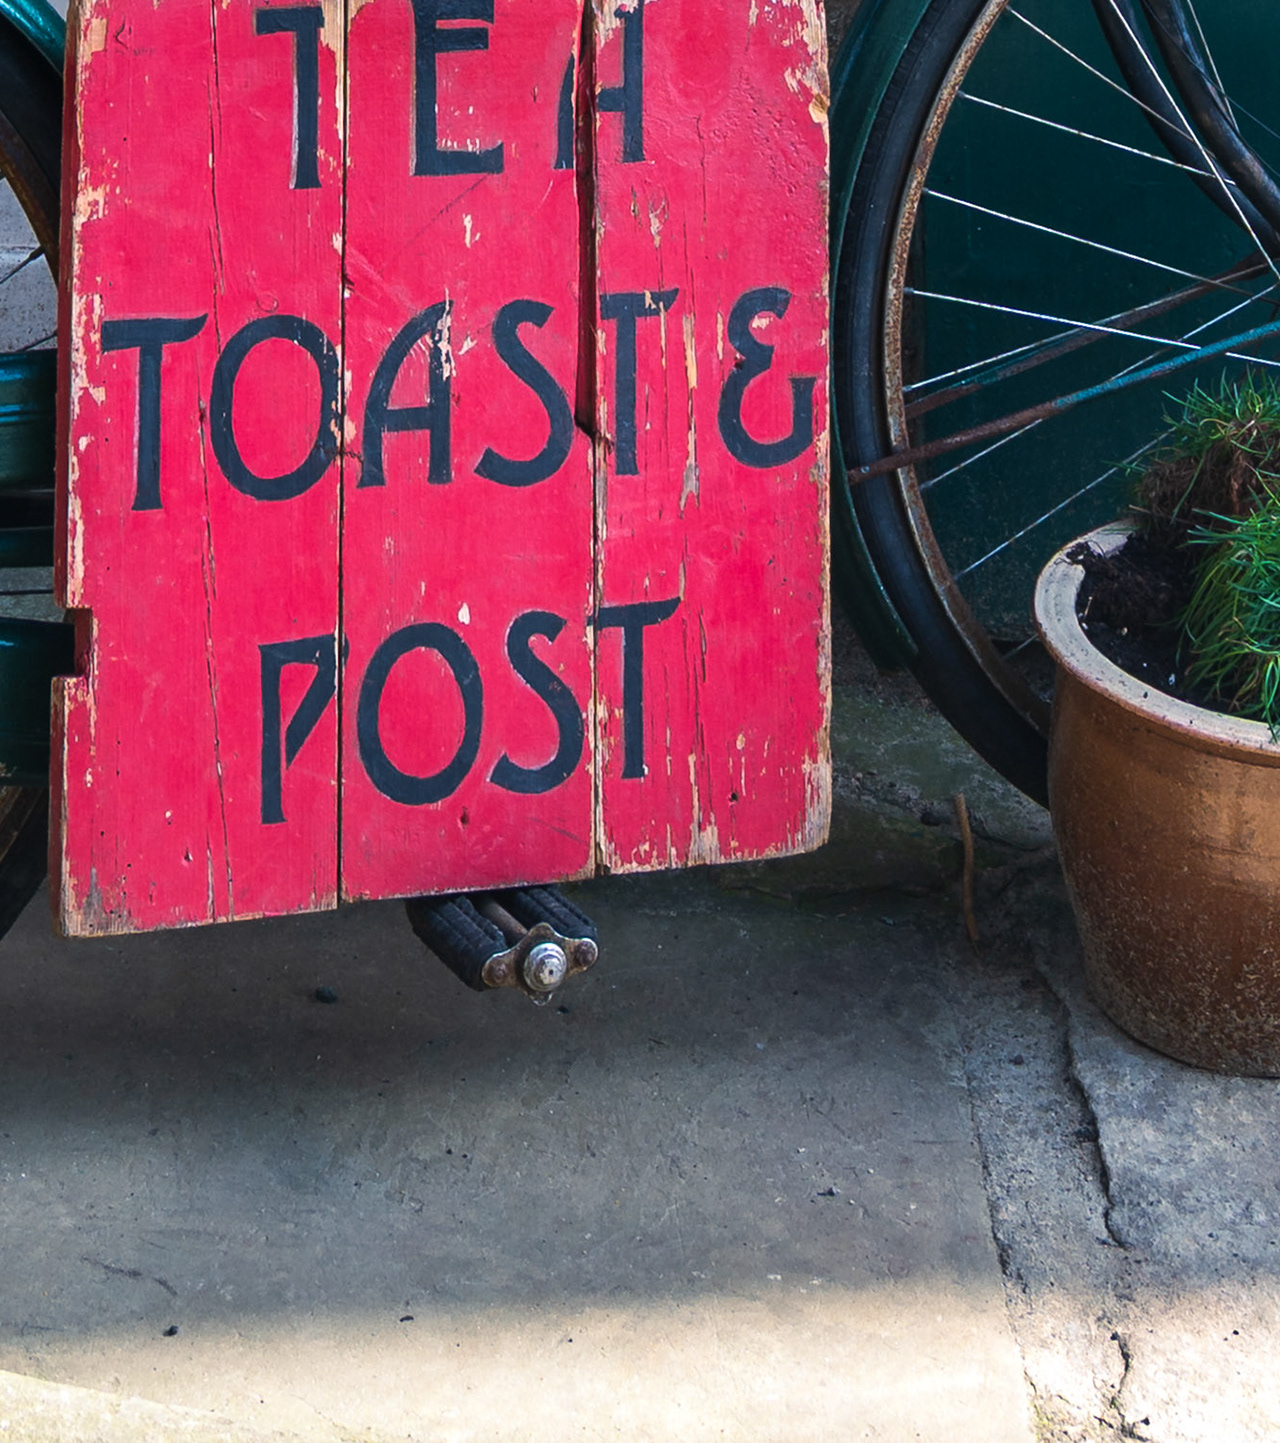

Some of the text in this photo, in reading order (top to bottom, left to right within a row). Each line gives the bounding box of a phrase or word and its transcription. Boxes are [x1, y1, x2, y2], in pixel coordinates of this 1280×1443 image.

[99, 285, 819, 512] TOAST &
[257, 595, 682, 825] POST
